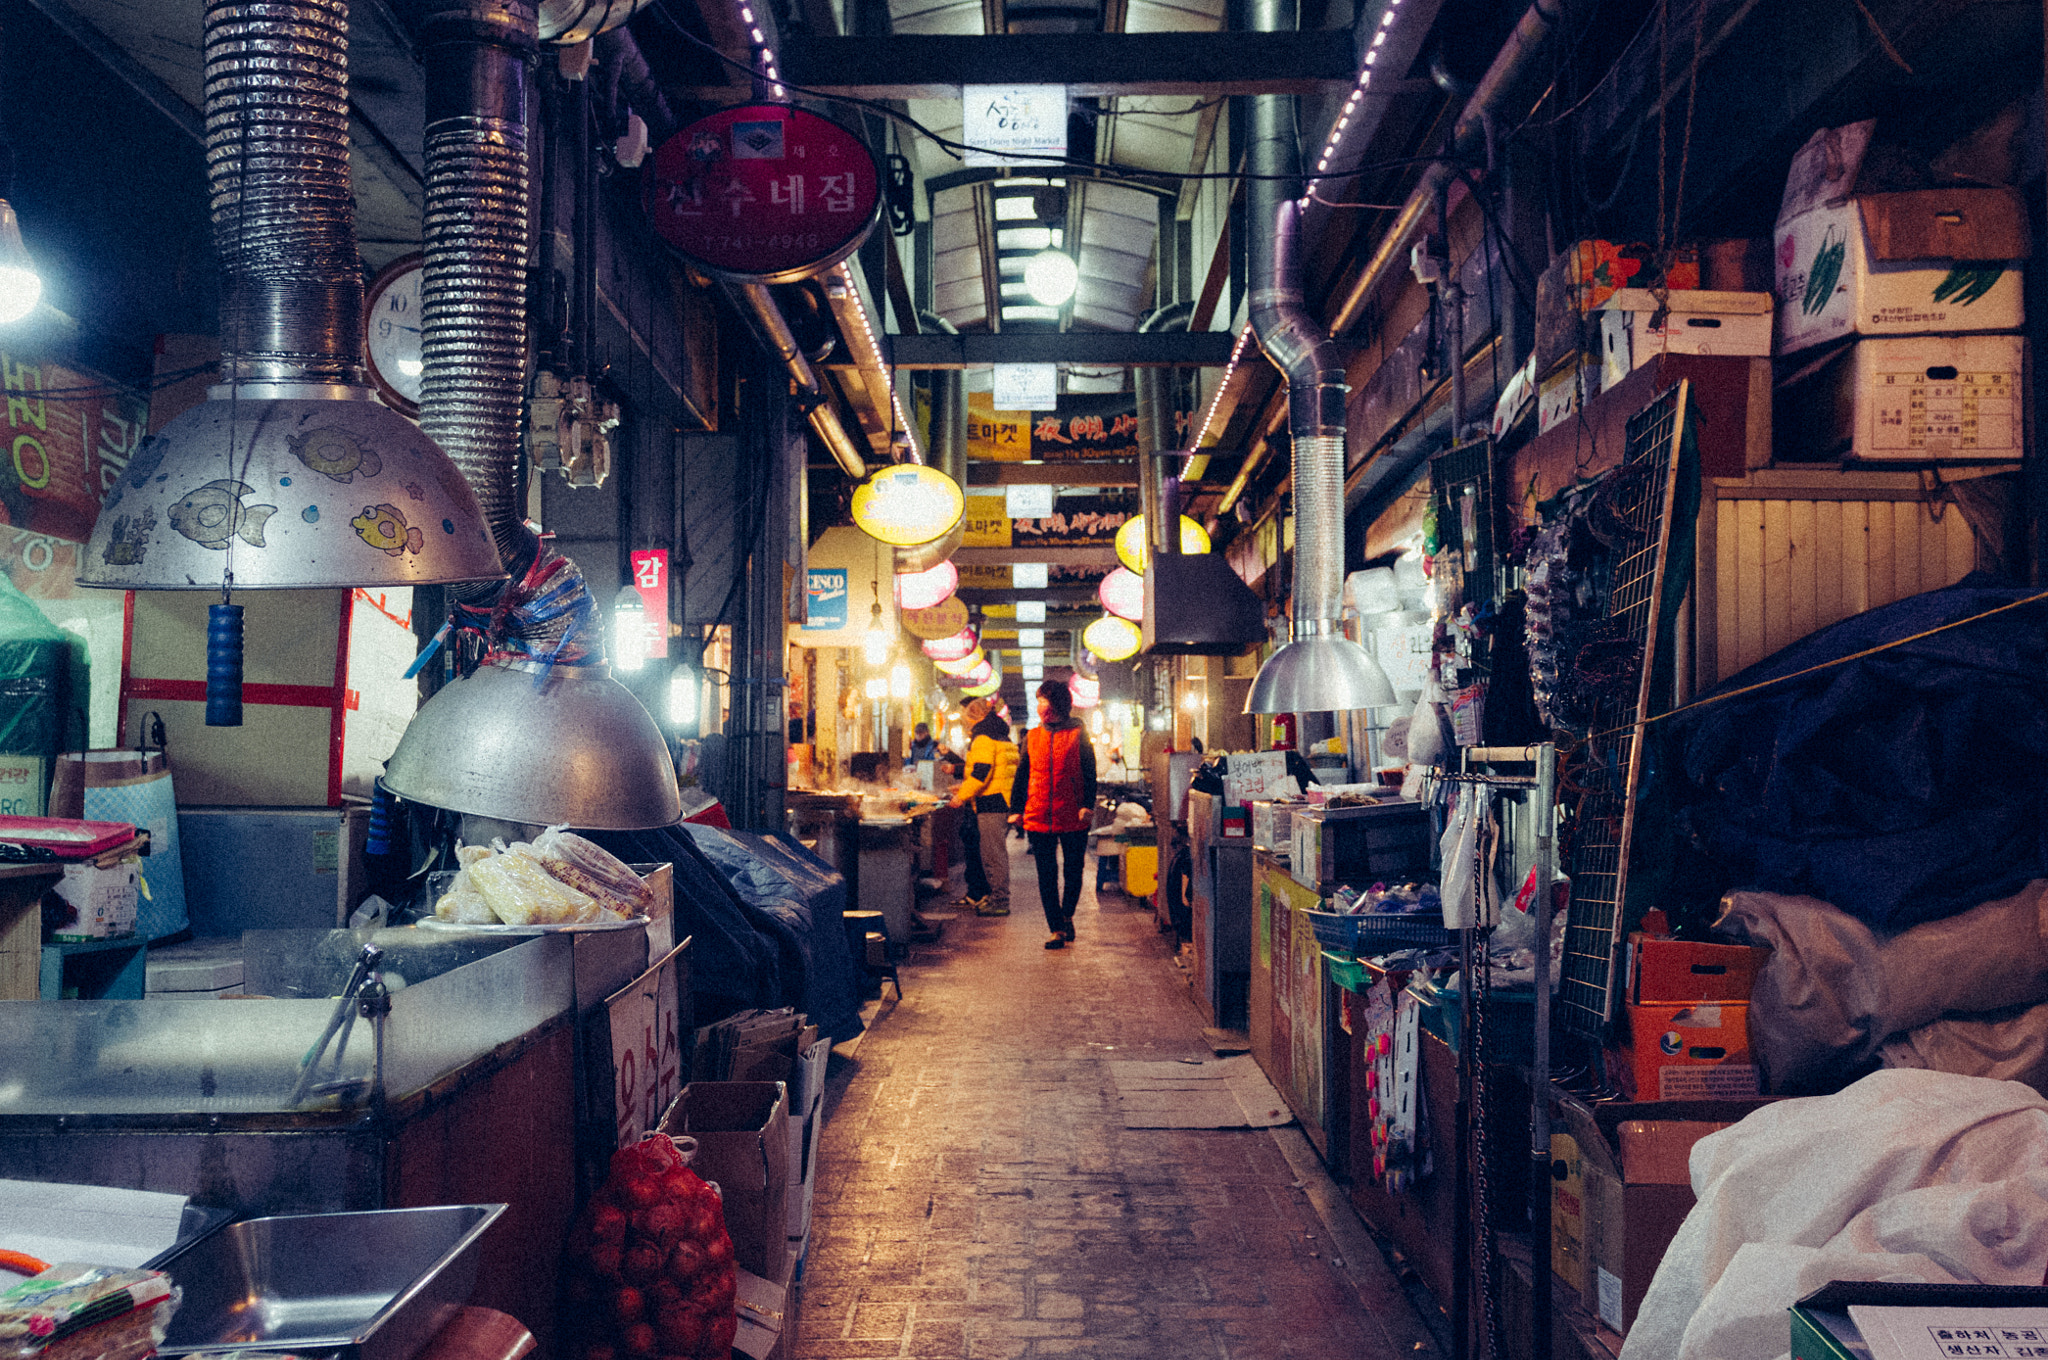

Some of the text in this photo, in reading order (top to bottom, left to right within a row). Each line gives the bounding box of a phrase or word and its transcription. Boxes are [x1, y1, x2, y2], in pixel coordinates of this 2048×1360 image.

[1034, 137, 1060, 145] Market
[390, 293, 408, 312] 10
[378, 318, 392, 339] 9
[967, 423, 1018, 445] 트마켓
[965, 520, 1003, 535] 트마켓
[1947, 1344, 2000, 1356] 생산자
